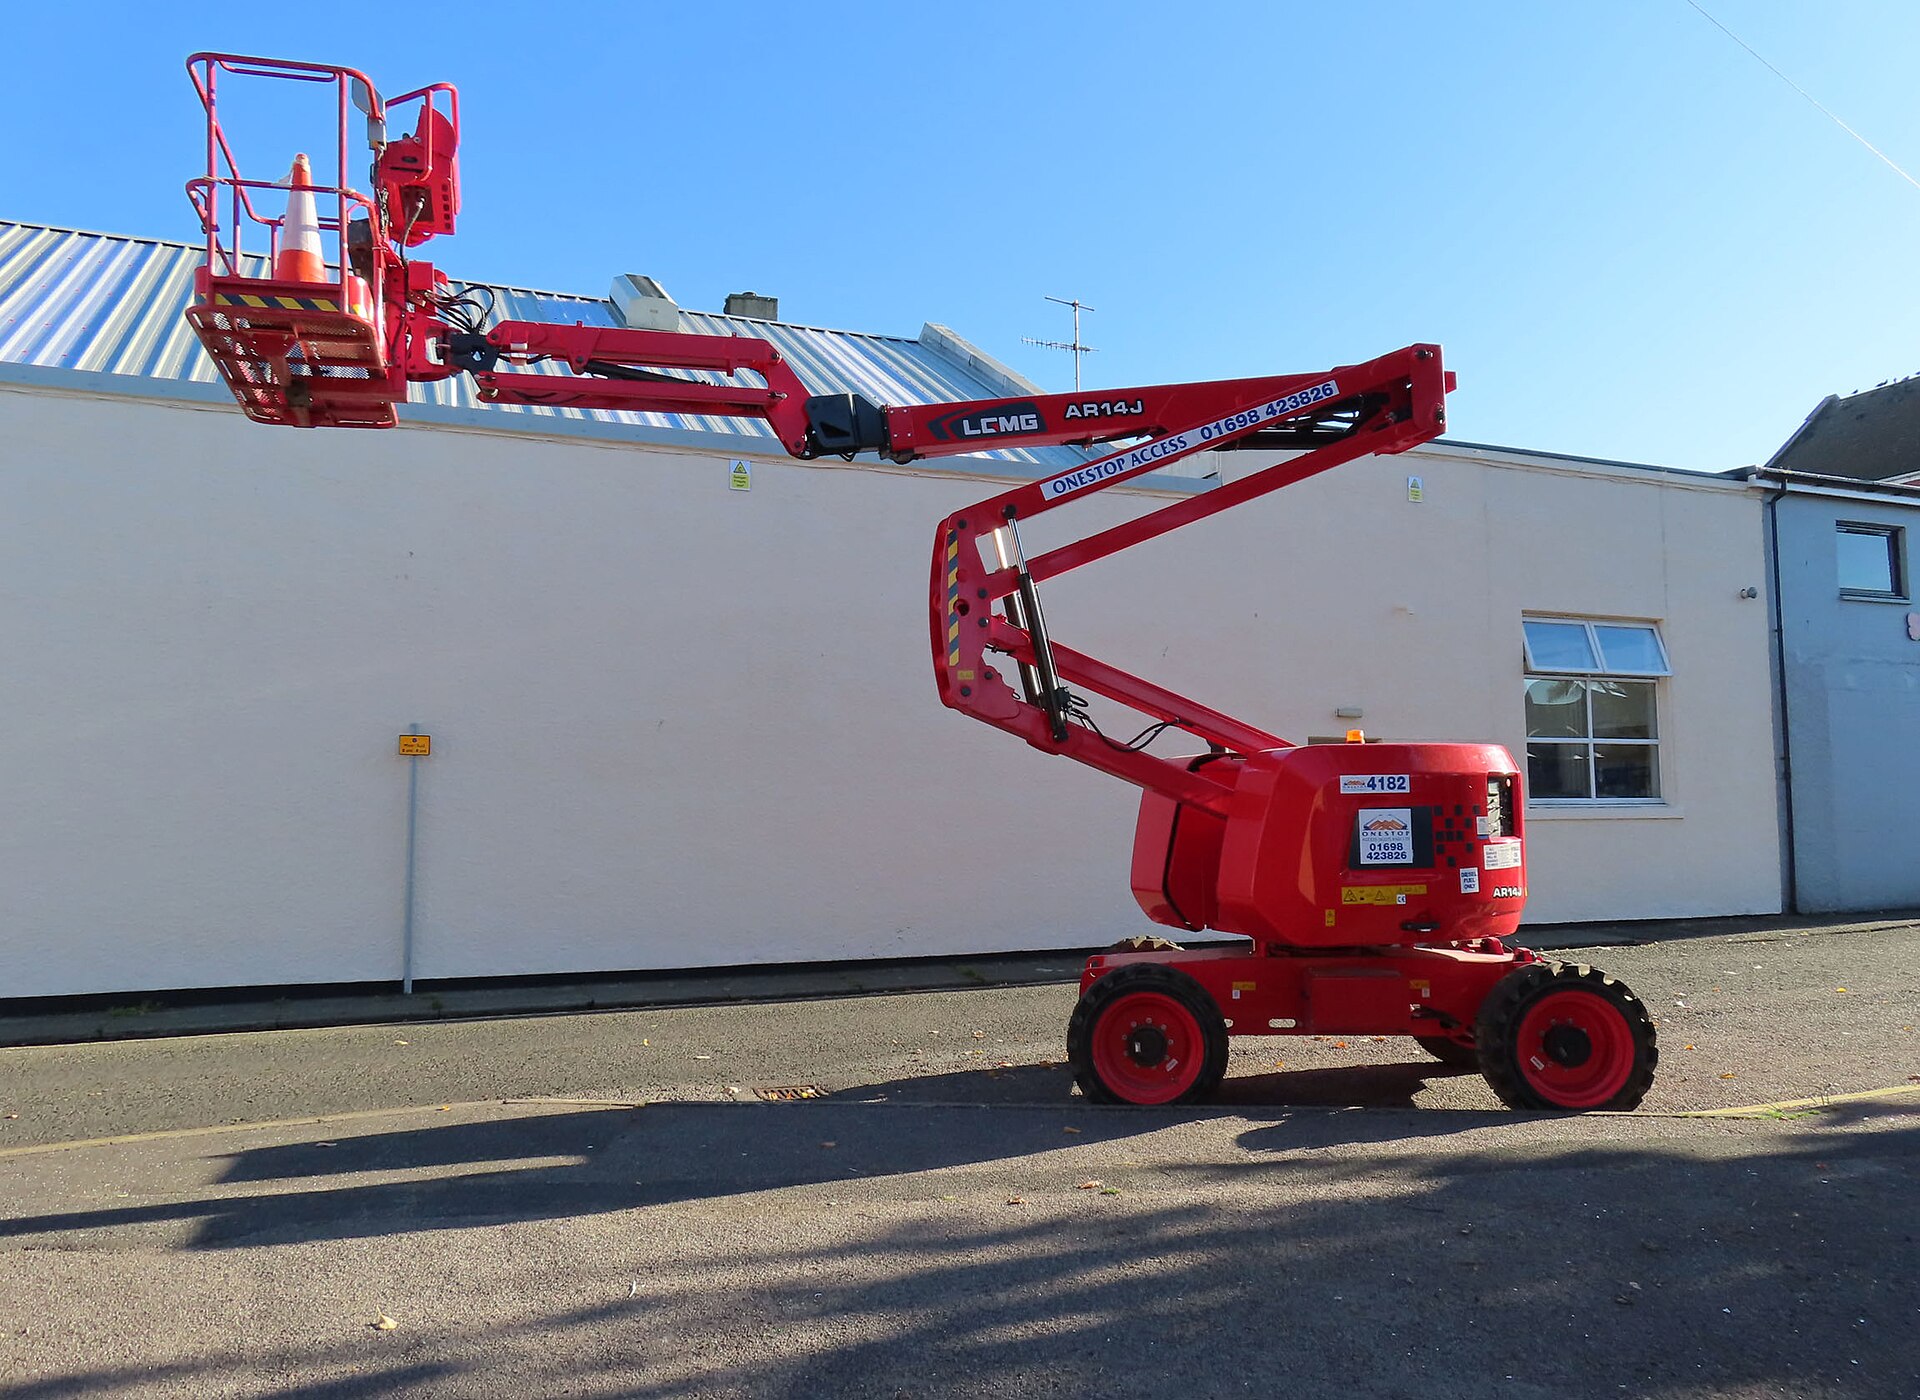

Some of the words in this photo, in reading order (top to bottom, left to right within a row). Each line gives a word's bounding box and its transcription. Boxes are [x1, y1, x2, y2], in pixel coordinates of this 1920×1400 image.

[1065, 400, 1143, 419] AR14J
[1053, 459, 1125, 494] ONESTOP
[1131, 436, 1187, 467] ACCESS
[1200, 410, 1260, 440] 01698
[1265, 383, 1334, 418] 423826
[1367, 776, 1406, 790] 4182
[1369, 843, 1403, 851] 01698
[1366, 851, 1407, 860] 423826
[1493, 887, 1522, 898] AR14J
